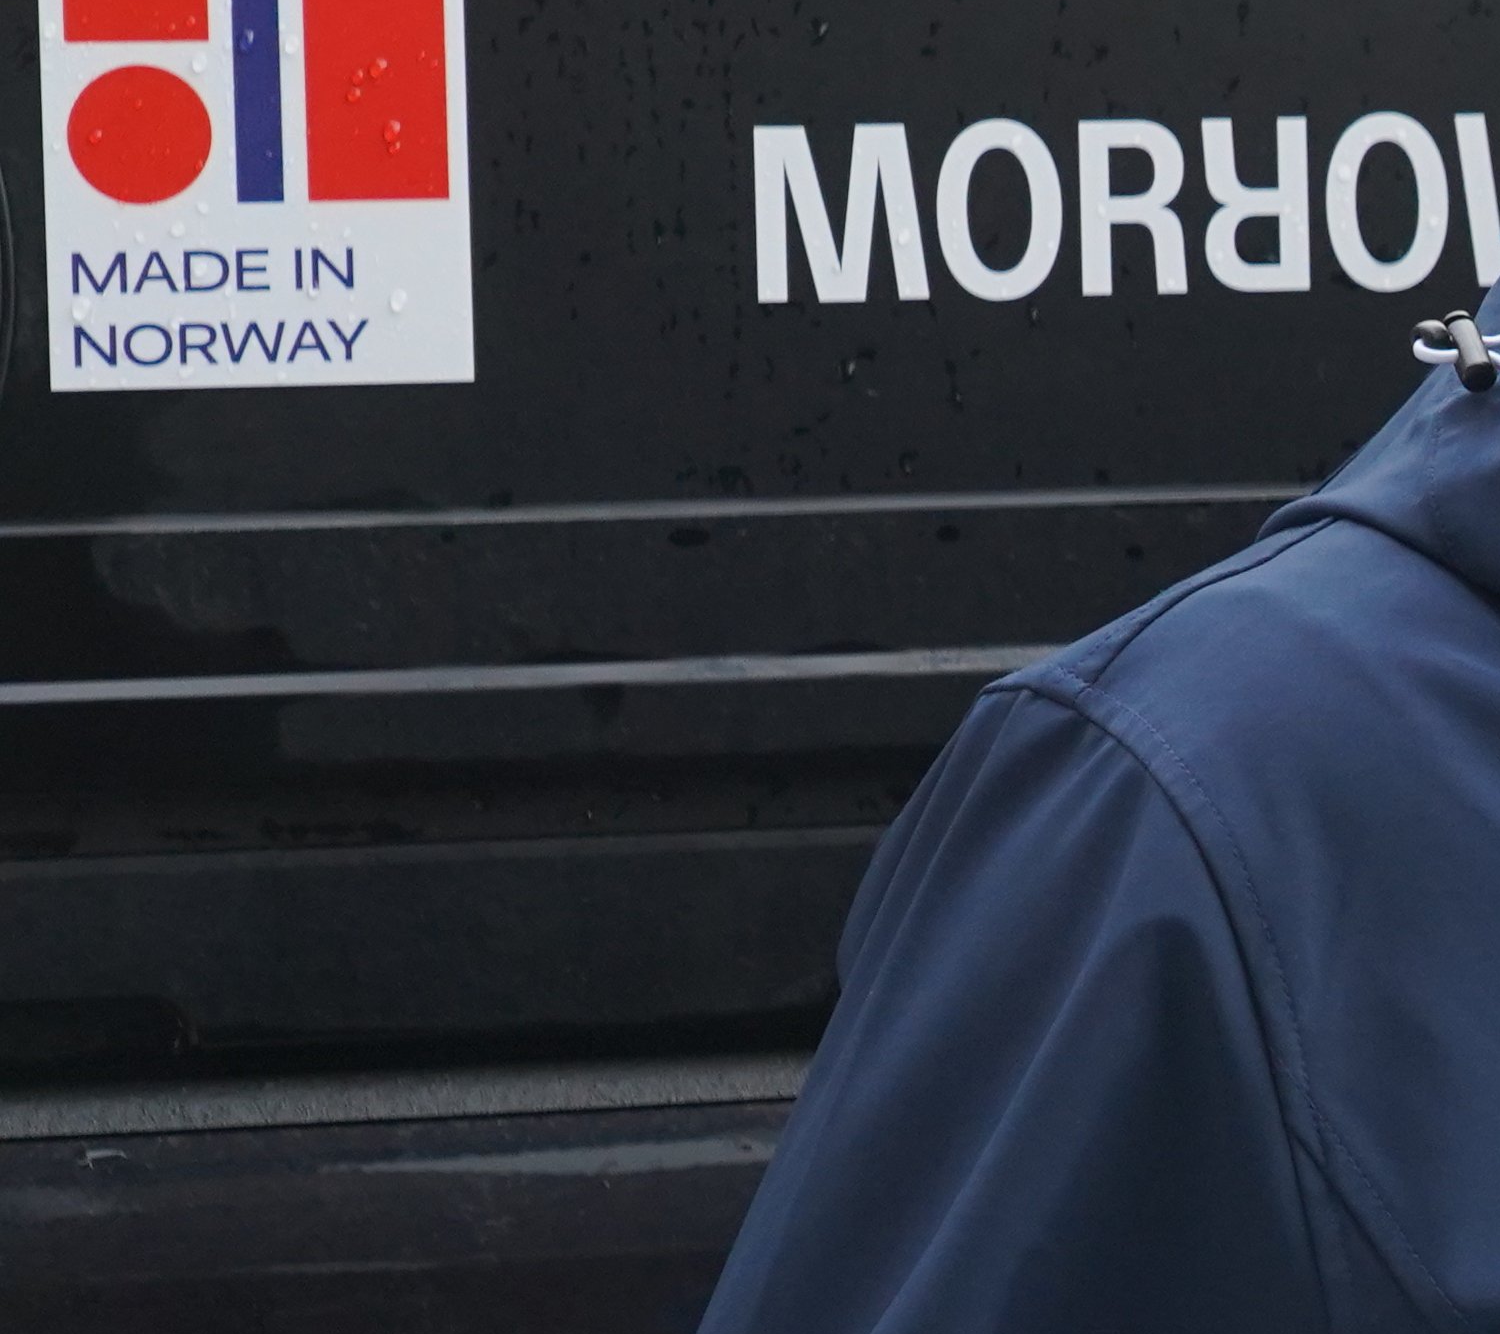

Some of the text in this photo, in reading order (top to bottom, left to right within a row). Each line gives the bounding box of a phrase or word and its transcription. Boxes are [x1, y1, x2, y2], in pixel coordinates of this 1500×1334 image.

[71, 247, 355, 295] MADE IN
[73, 319, 368, 368] NORWAY
